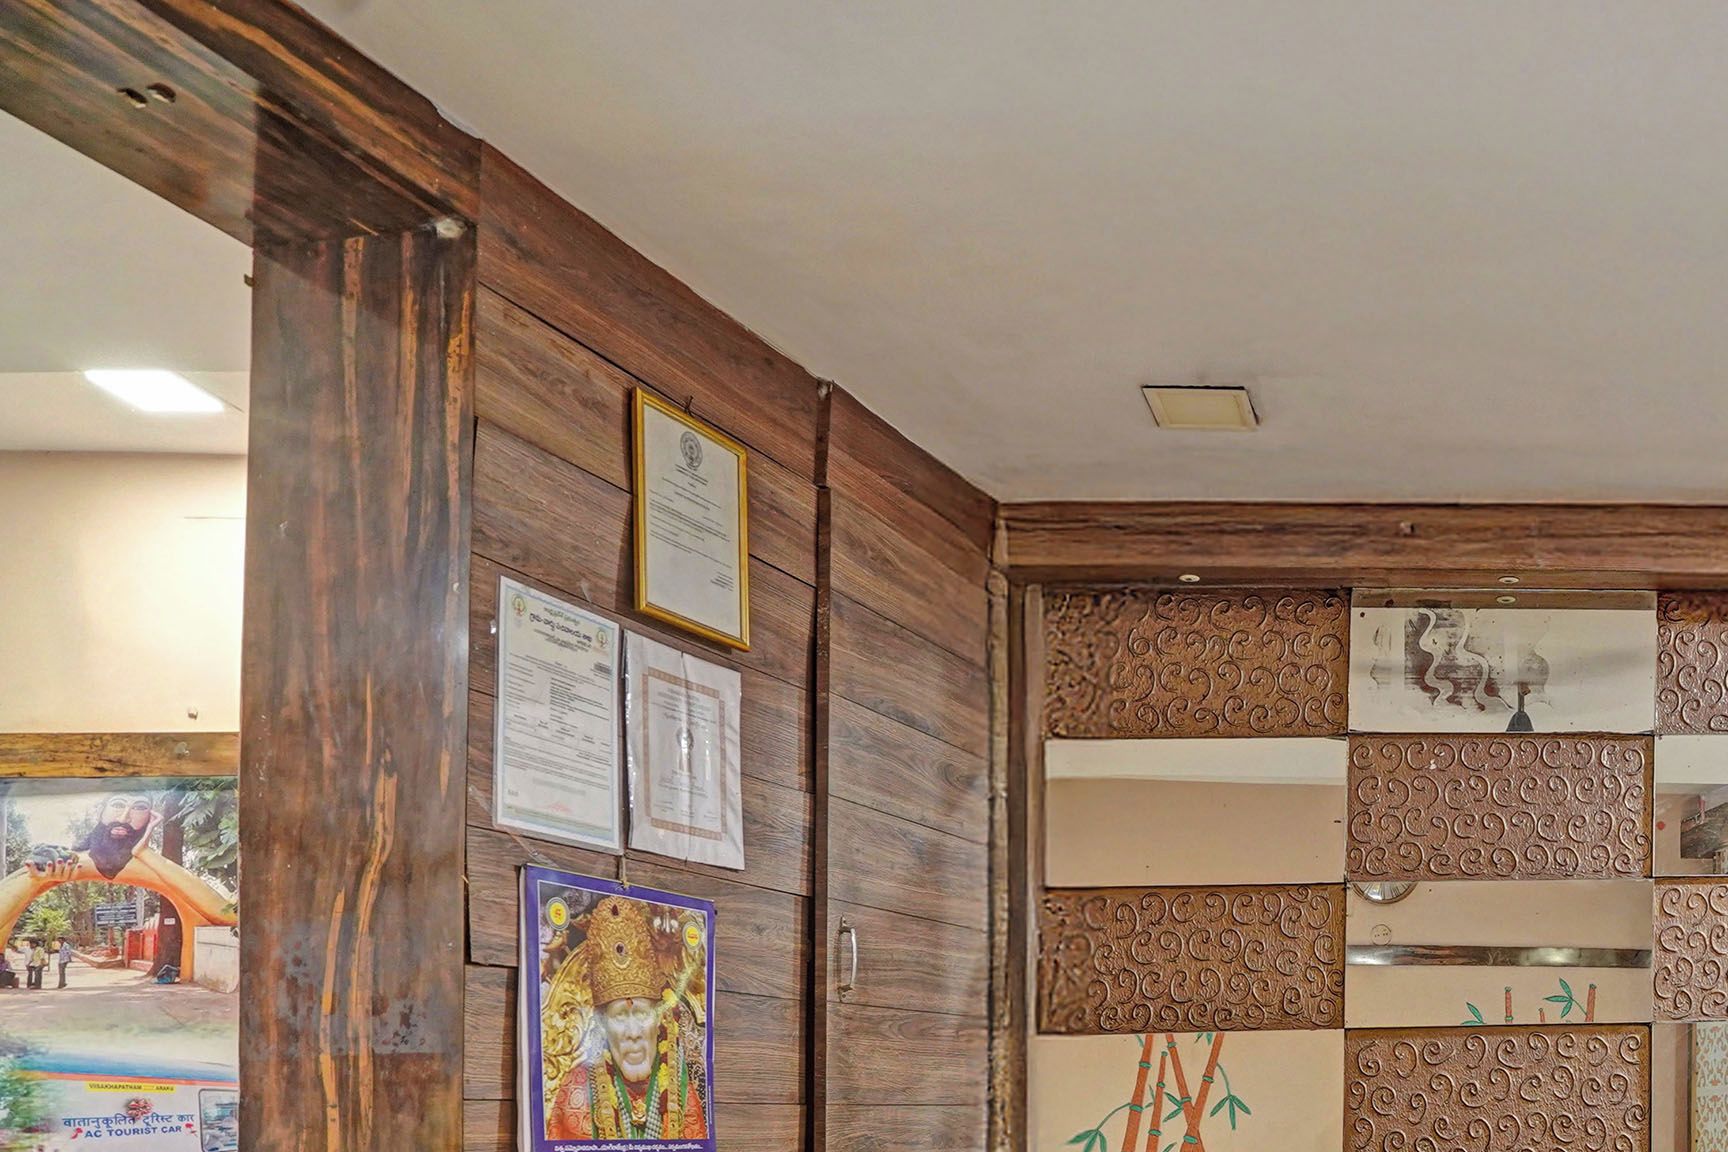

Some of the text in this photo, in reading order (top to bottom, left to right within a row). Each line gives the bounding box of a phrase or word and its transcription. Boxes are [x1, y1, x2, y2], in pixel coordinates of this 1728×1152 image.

[142, 1112, 173, 1126] टूरिस्ट
[177, 1114, 195, 1122] कार
[84, 1125, 182, 1138] AC TOURIST CAR
